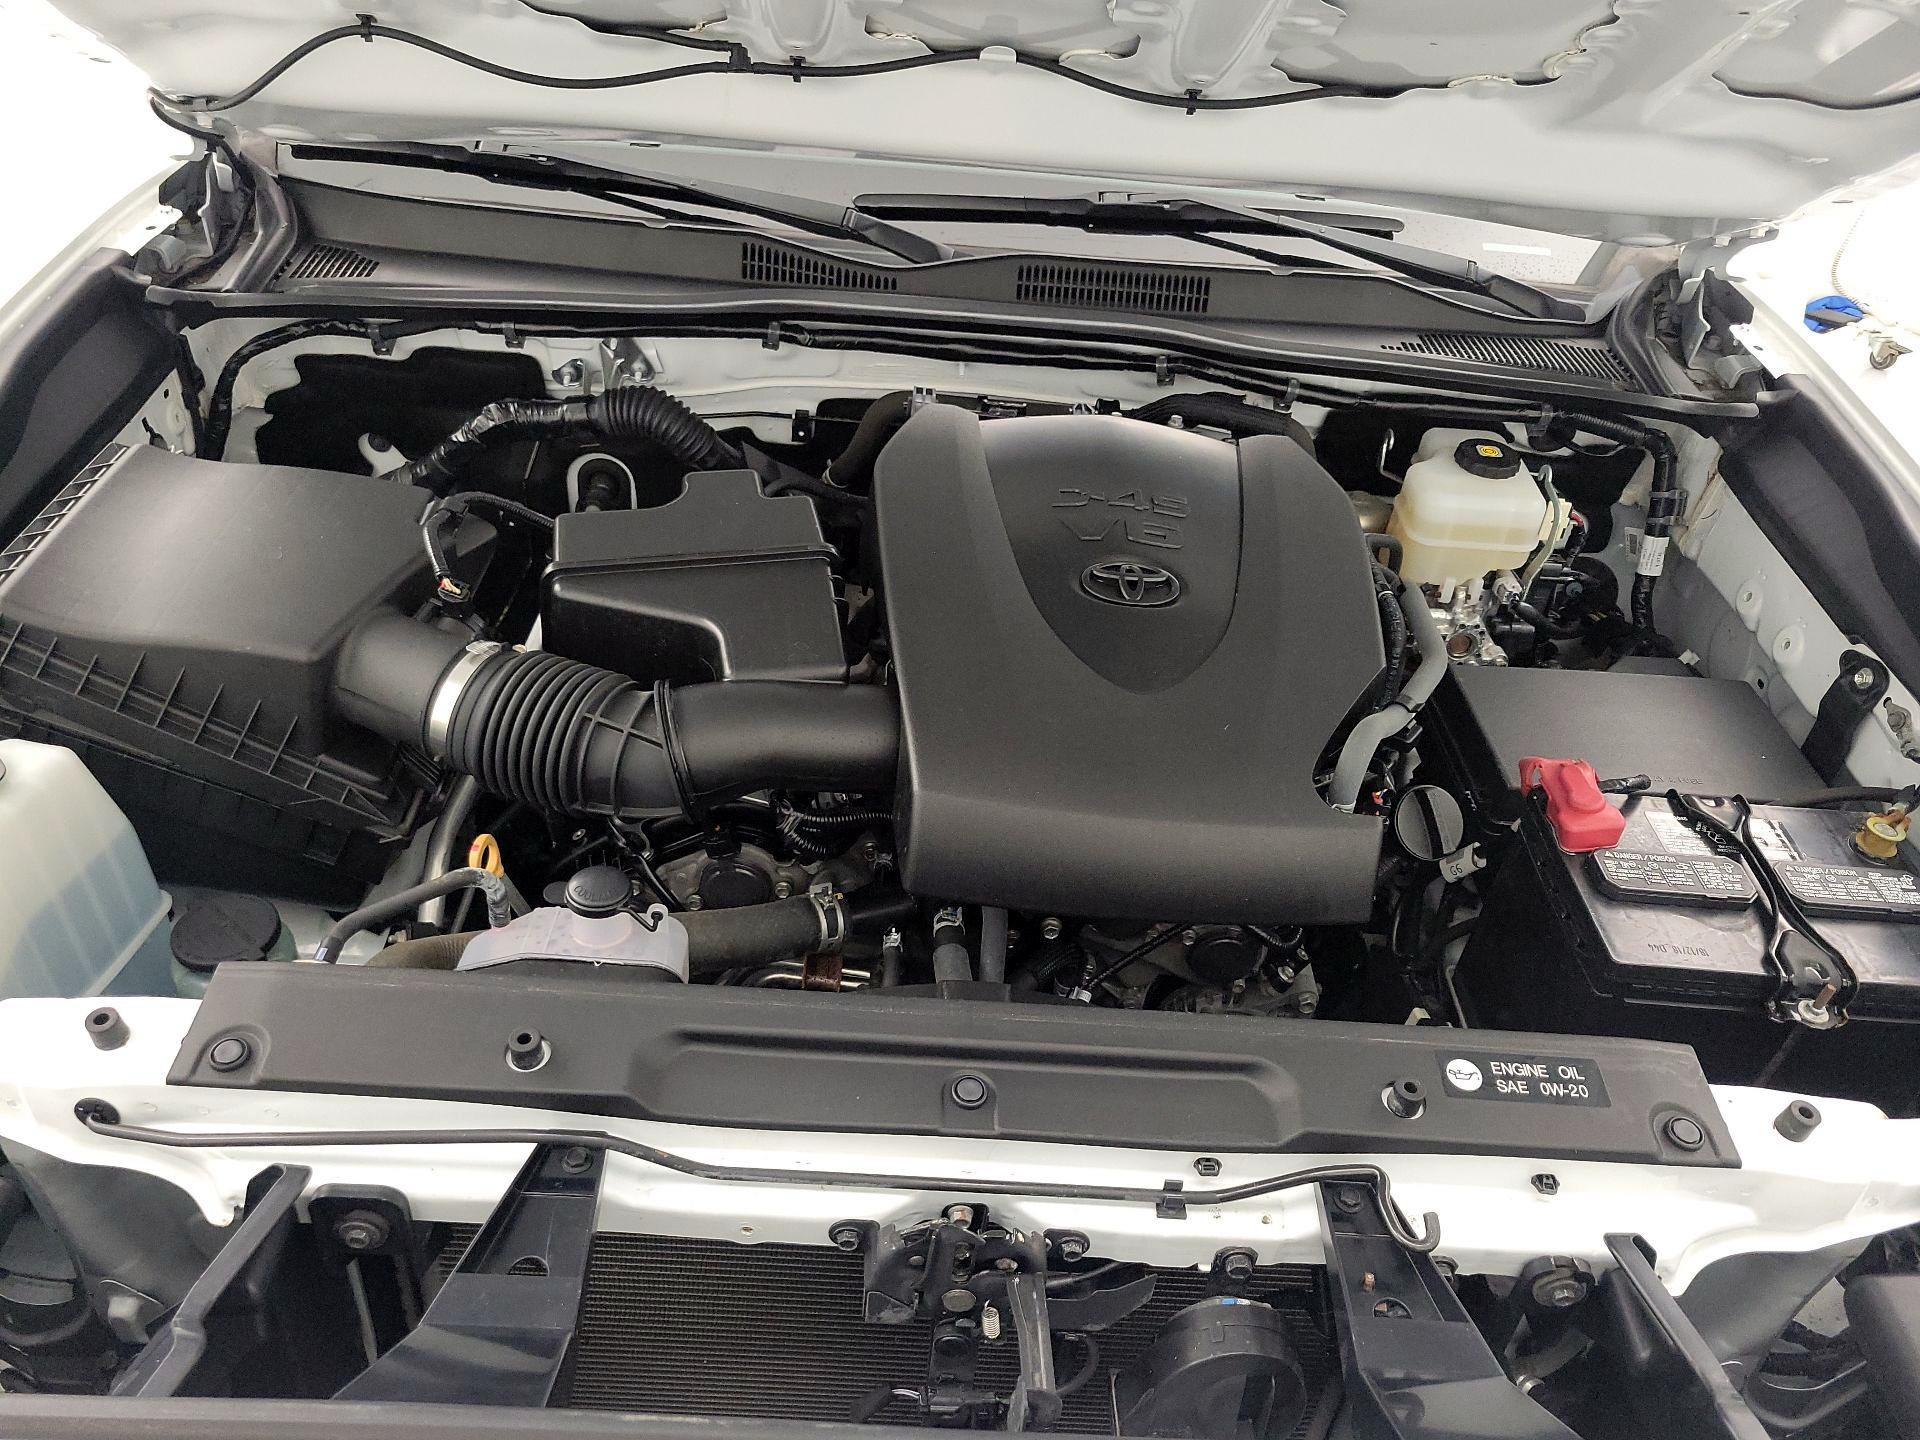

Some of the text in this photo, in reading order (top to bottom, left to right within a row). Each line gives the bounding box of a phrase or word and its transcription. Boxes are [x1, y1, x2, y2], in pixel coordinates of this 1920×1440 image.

[1057, 517, 1184, 550] V6
[1449, 863, 1463, 876] G6
[1489, 1061, 1586, 1081] ENGINE OIL
[1496, 1080, 1589, 1098] SAE 0W-20
